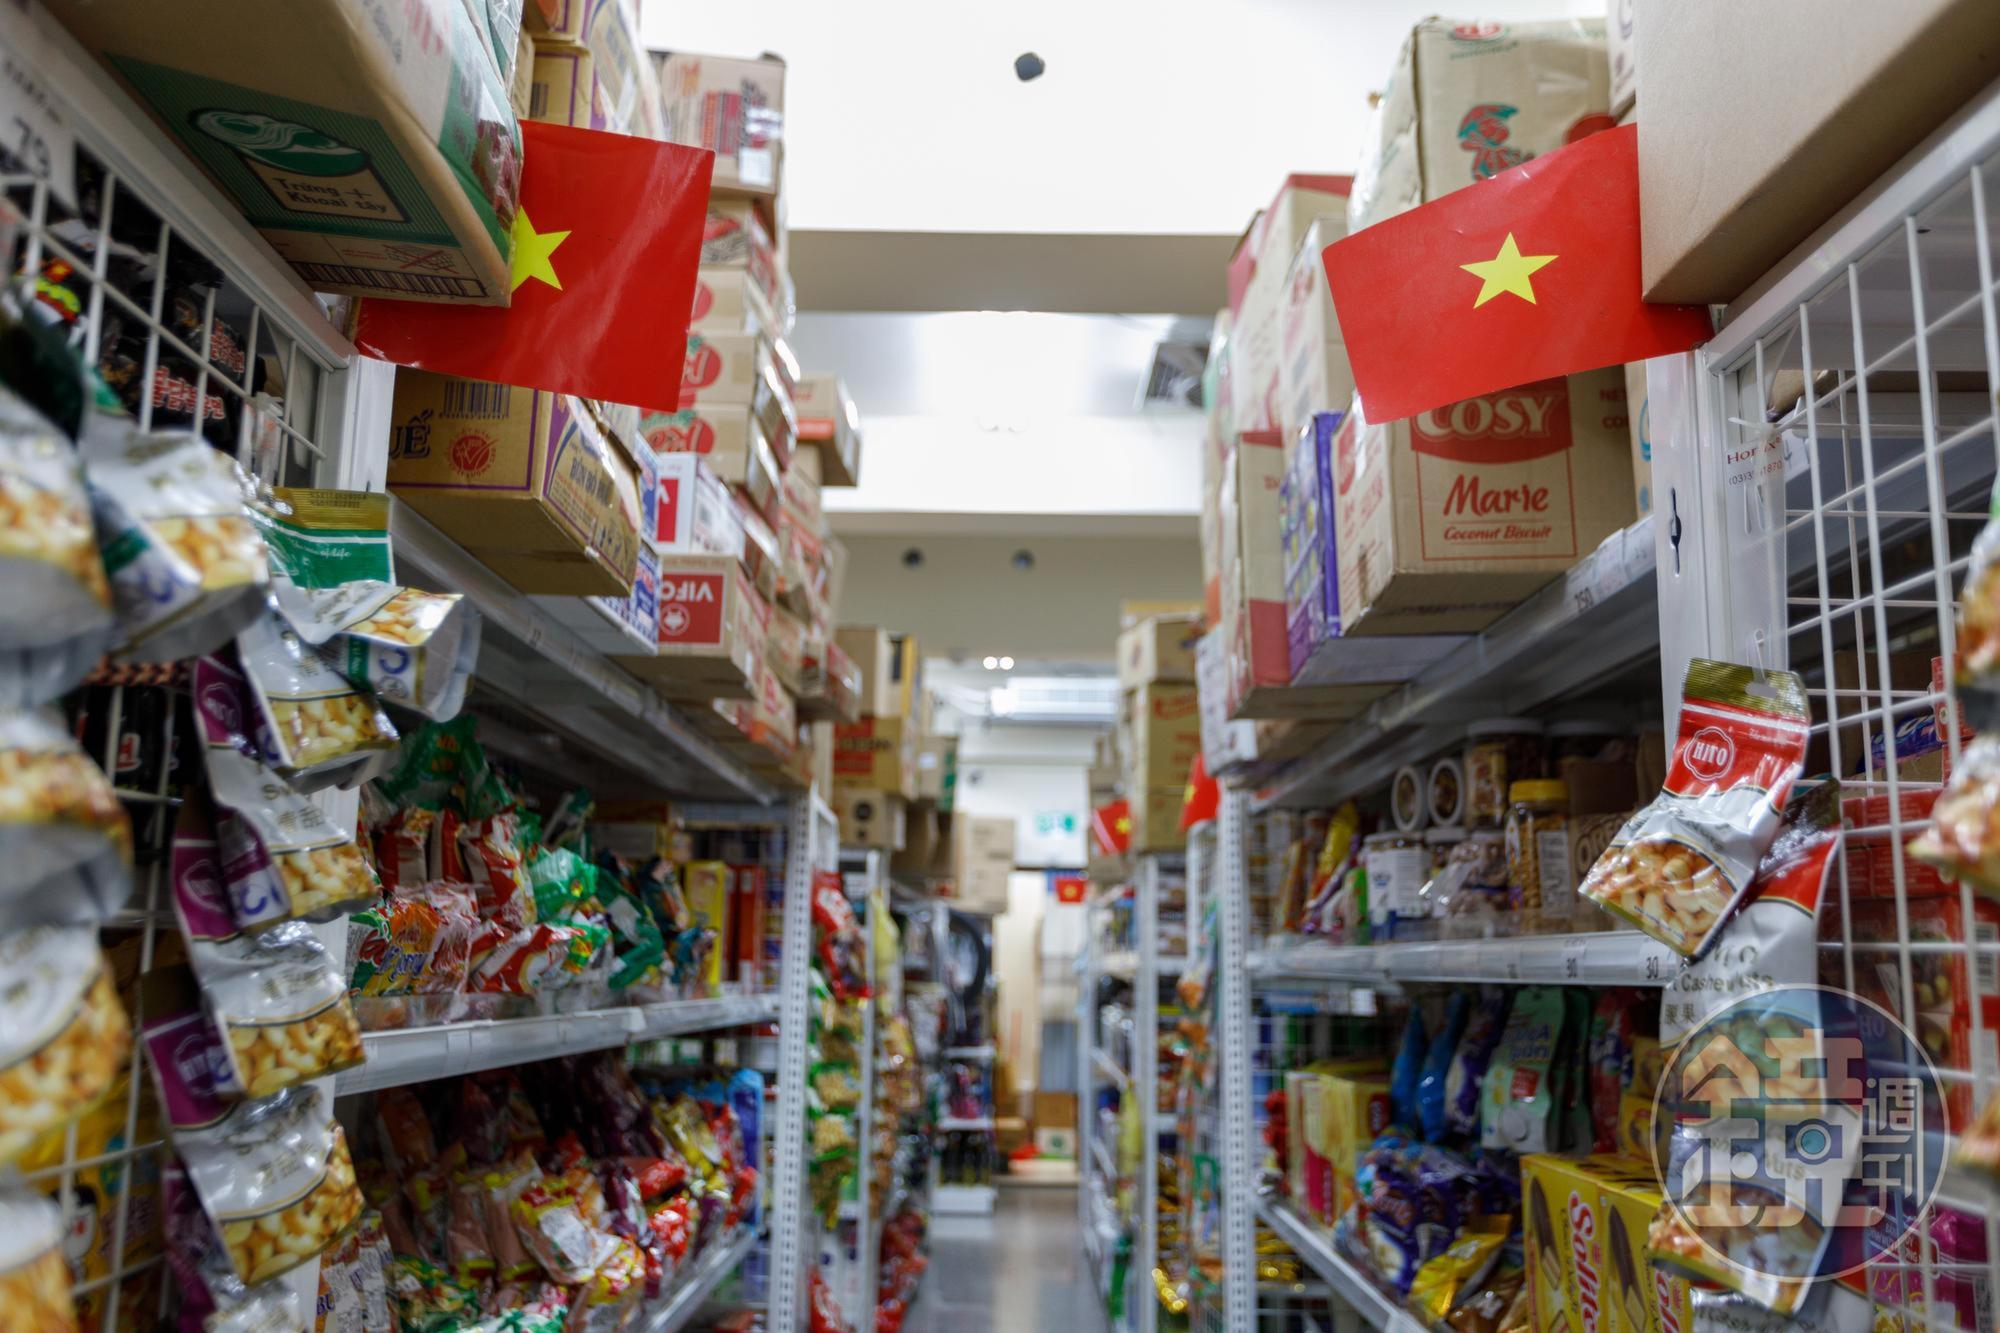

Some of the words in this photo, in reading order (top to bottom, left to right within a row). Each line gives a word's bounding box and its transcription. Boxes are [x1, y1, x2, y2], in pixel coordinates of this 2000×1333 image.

[287, 191, 348, 208] Khoai
[1443, 473, 1549, 517] Marie
[1444, 525, 1500, 541] Coconut
[1503, 523, 1552, 540] Biscuit
[1645, 956, 1659, 980] 30
